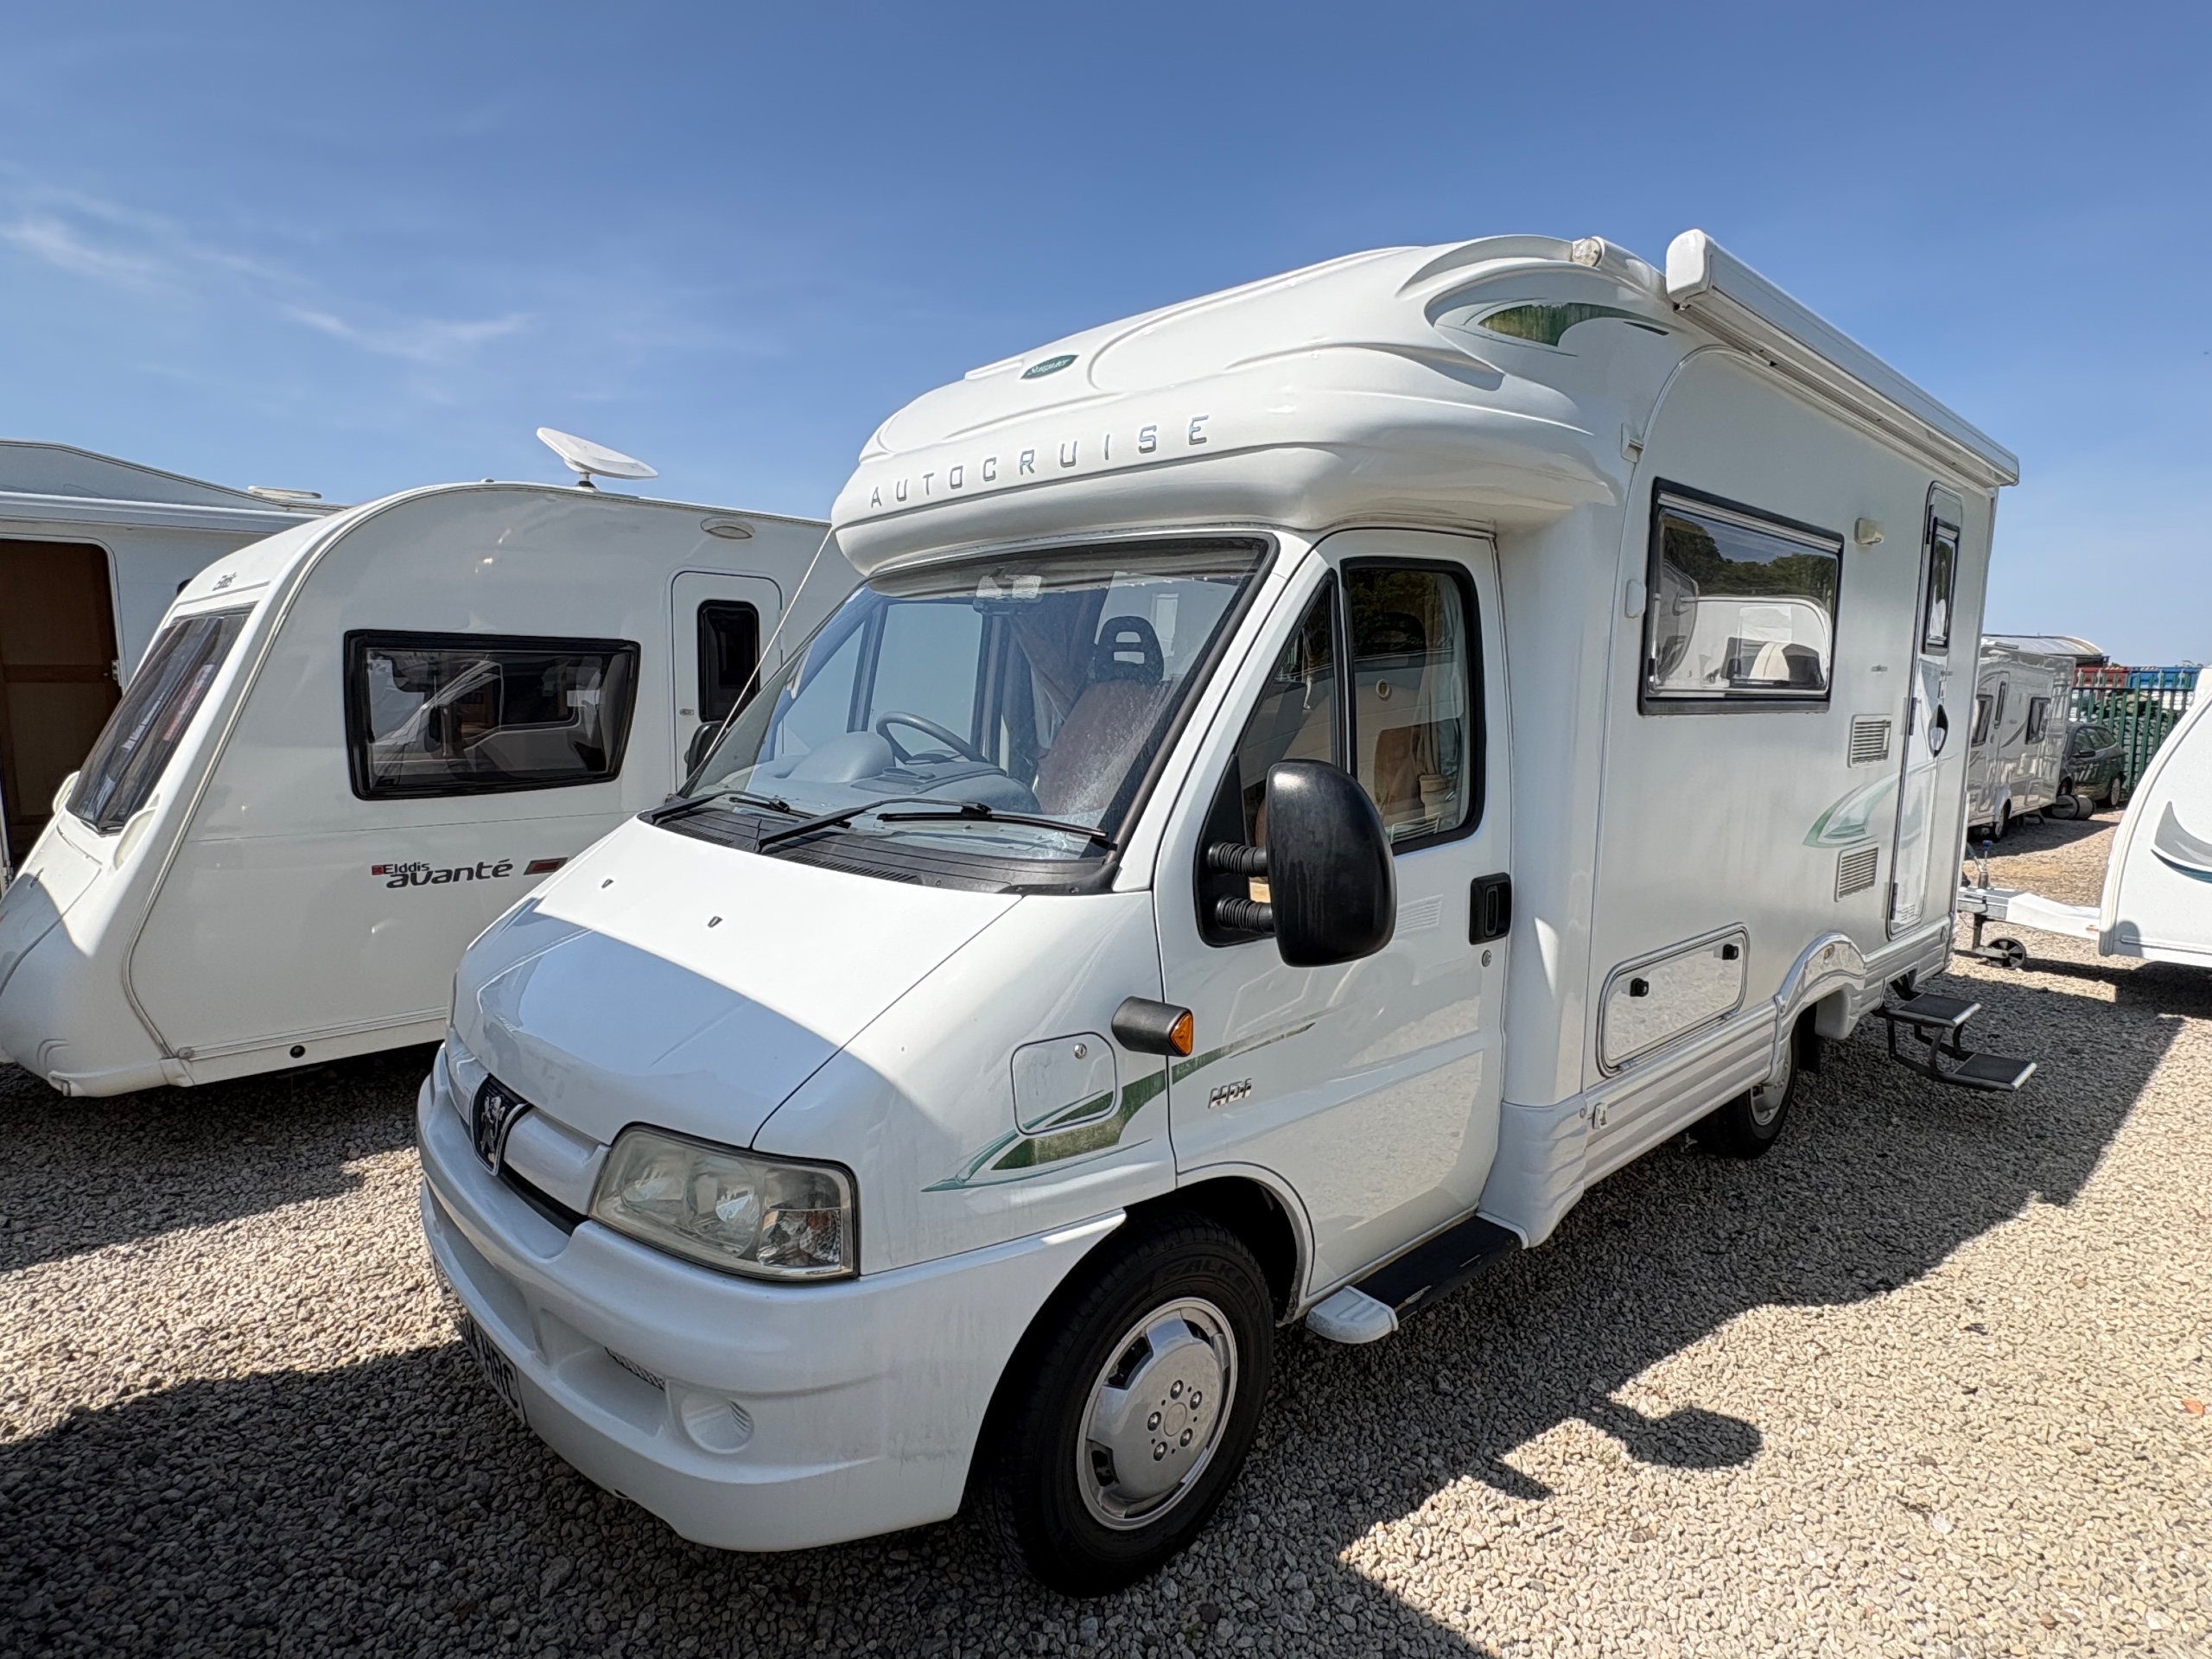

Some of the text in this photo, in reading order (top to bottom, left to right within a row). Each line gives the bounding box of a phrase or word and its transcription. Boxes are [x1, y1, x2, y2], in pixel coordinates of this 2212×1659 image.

[870, 415, 1209, 509] AUTOCRUISE
[384, 861, 430, 874] Elddis
[385, 858, 514, 889] avanté
